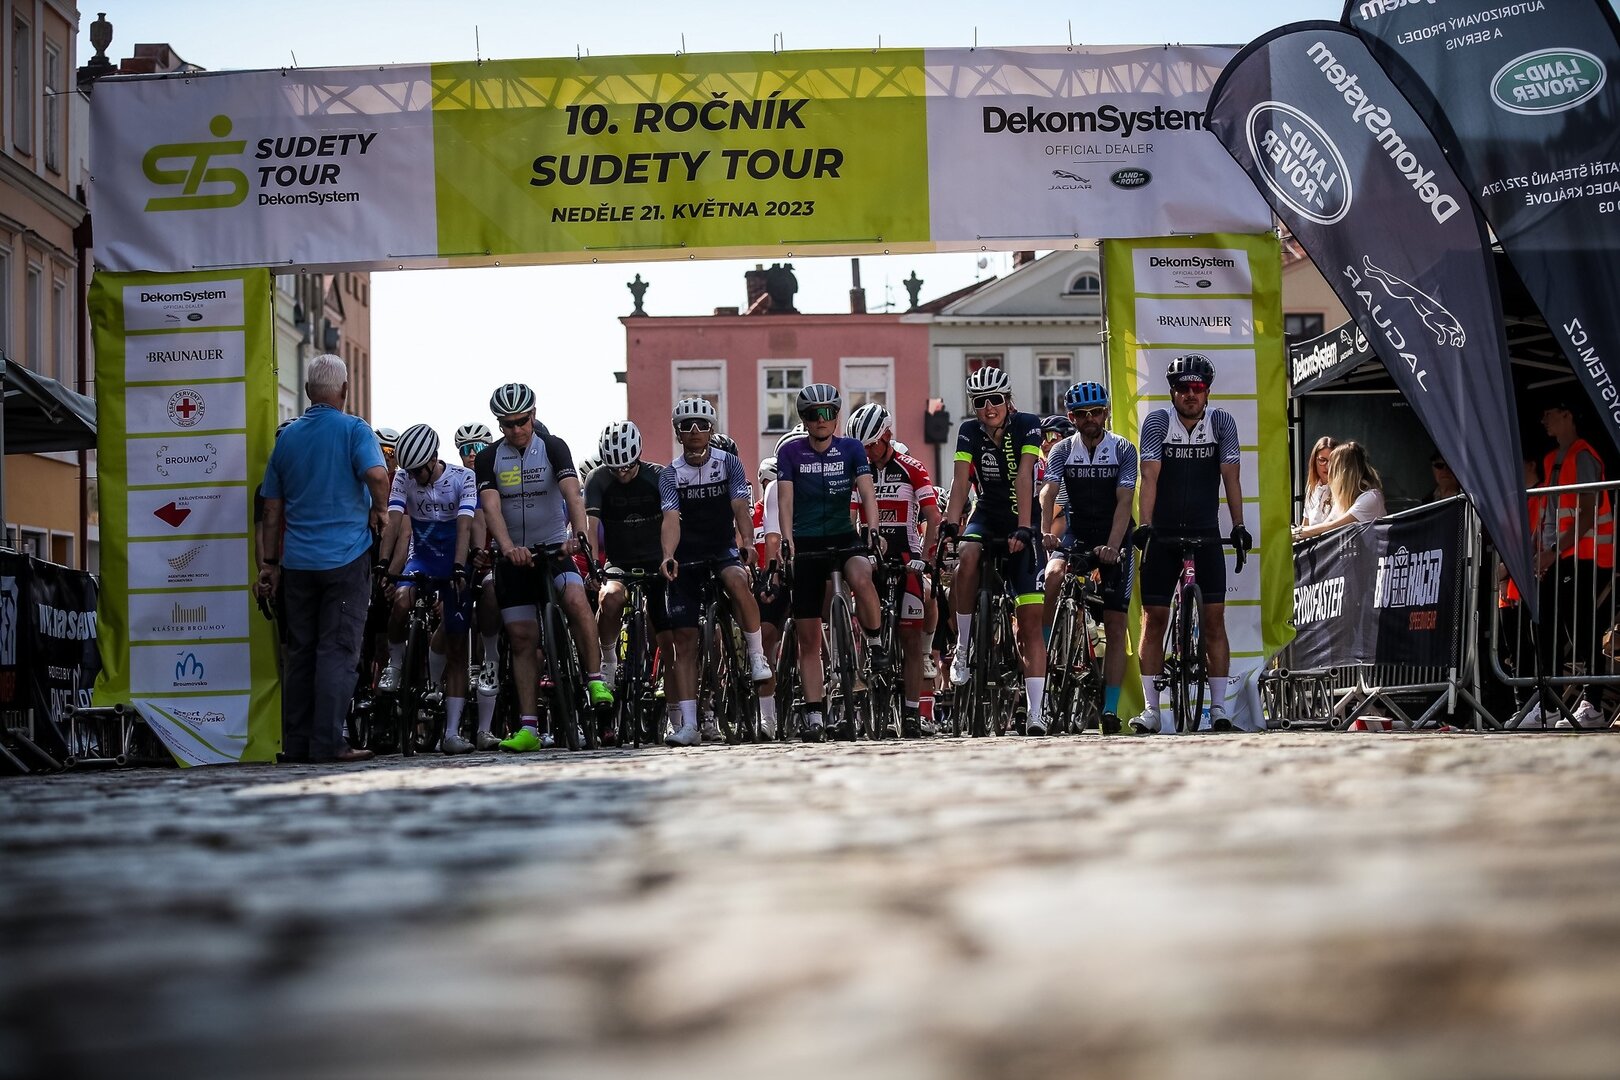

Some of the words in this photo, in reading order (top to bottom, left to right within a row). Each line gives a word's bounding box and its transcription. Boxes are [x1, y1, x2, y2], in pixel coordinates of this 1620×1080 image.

[565, 104, 619, 136] 10.
[633, 91, 810, 134] ROČNÍK
[255, 133, 377, 160] SUDETY
[1045, 145, 1102, 156] OFFICIAL
[1105, 143, 1154, 154] DEALER
[529, 150, 711, 187] SUDETY
[721, 148, 844, 180] TOUR
[258, 164, 341, 188] TOUR
[1119, 177, 1145, 185] ROVER
[258, 189, 360, 207] DekomSystem
[551, 203, 635, 224] NEDĚLE
[639, 204, 666, 221] 21.
[672, 198, 759, 219] KVĚTNA
[765, 201, 815, 217] 2023
[1150, 256, 1235, 268] DekomSystem
[140, 290, 226, 303] DekomSystem
[1159, 315, 1232, 327] BRAUNAUER
[148, 349, 224, 363] BRAUNAUER
[1293, 341, 1338, 385] DekomSystem
[1175, 447, 1193, 458] BIKE
[165, 454, 210, 465] BROUMOV
[823, 461, 844, 472] RACER
[1077, 468, 1096, 478] BIKE
[687, 488, 706, 499] BIKE
[1405, 549, 1443, 607] RACER
[152, 624, 185, 632] KLÁŠTER
[187, 624, 227, 632] BROUMOV
